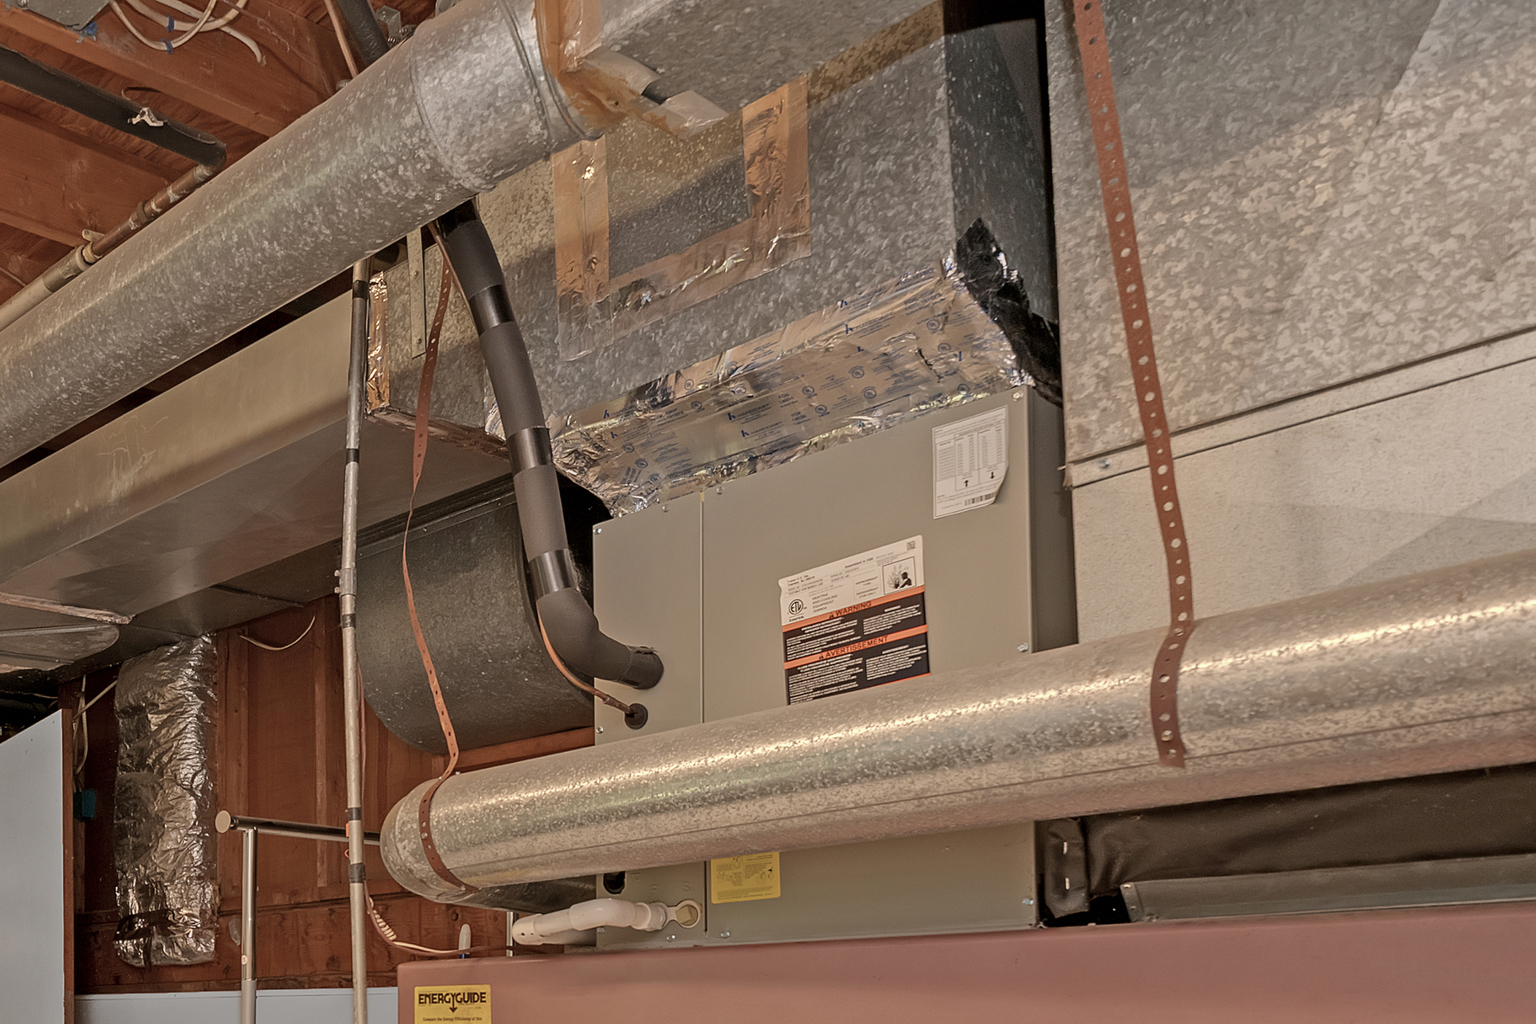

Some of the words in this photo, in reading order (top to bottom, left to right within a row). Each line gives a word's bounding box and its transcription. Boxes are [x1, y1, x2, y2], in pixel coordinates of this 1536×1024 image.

[836, 601, 872, 616] WARNING
[825, 636, 888, 658] AVERTISSEMENT
[418, 992, 487, 1005] ENERGYGUIDE
